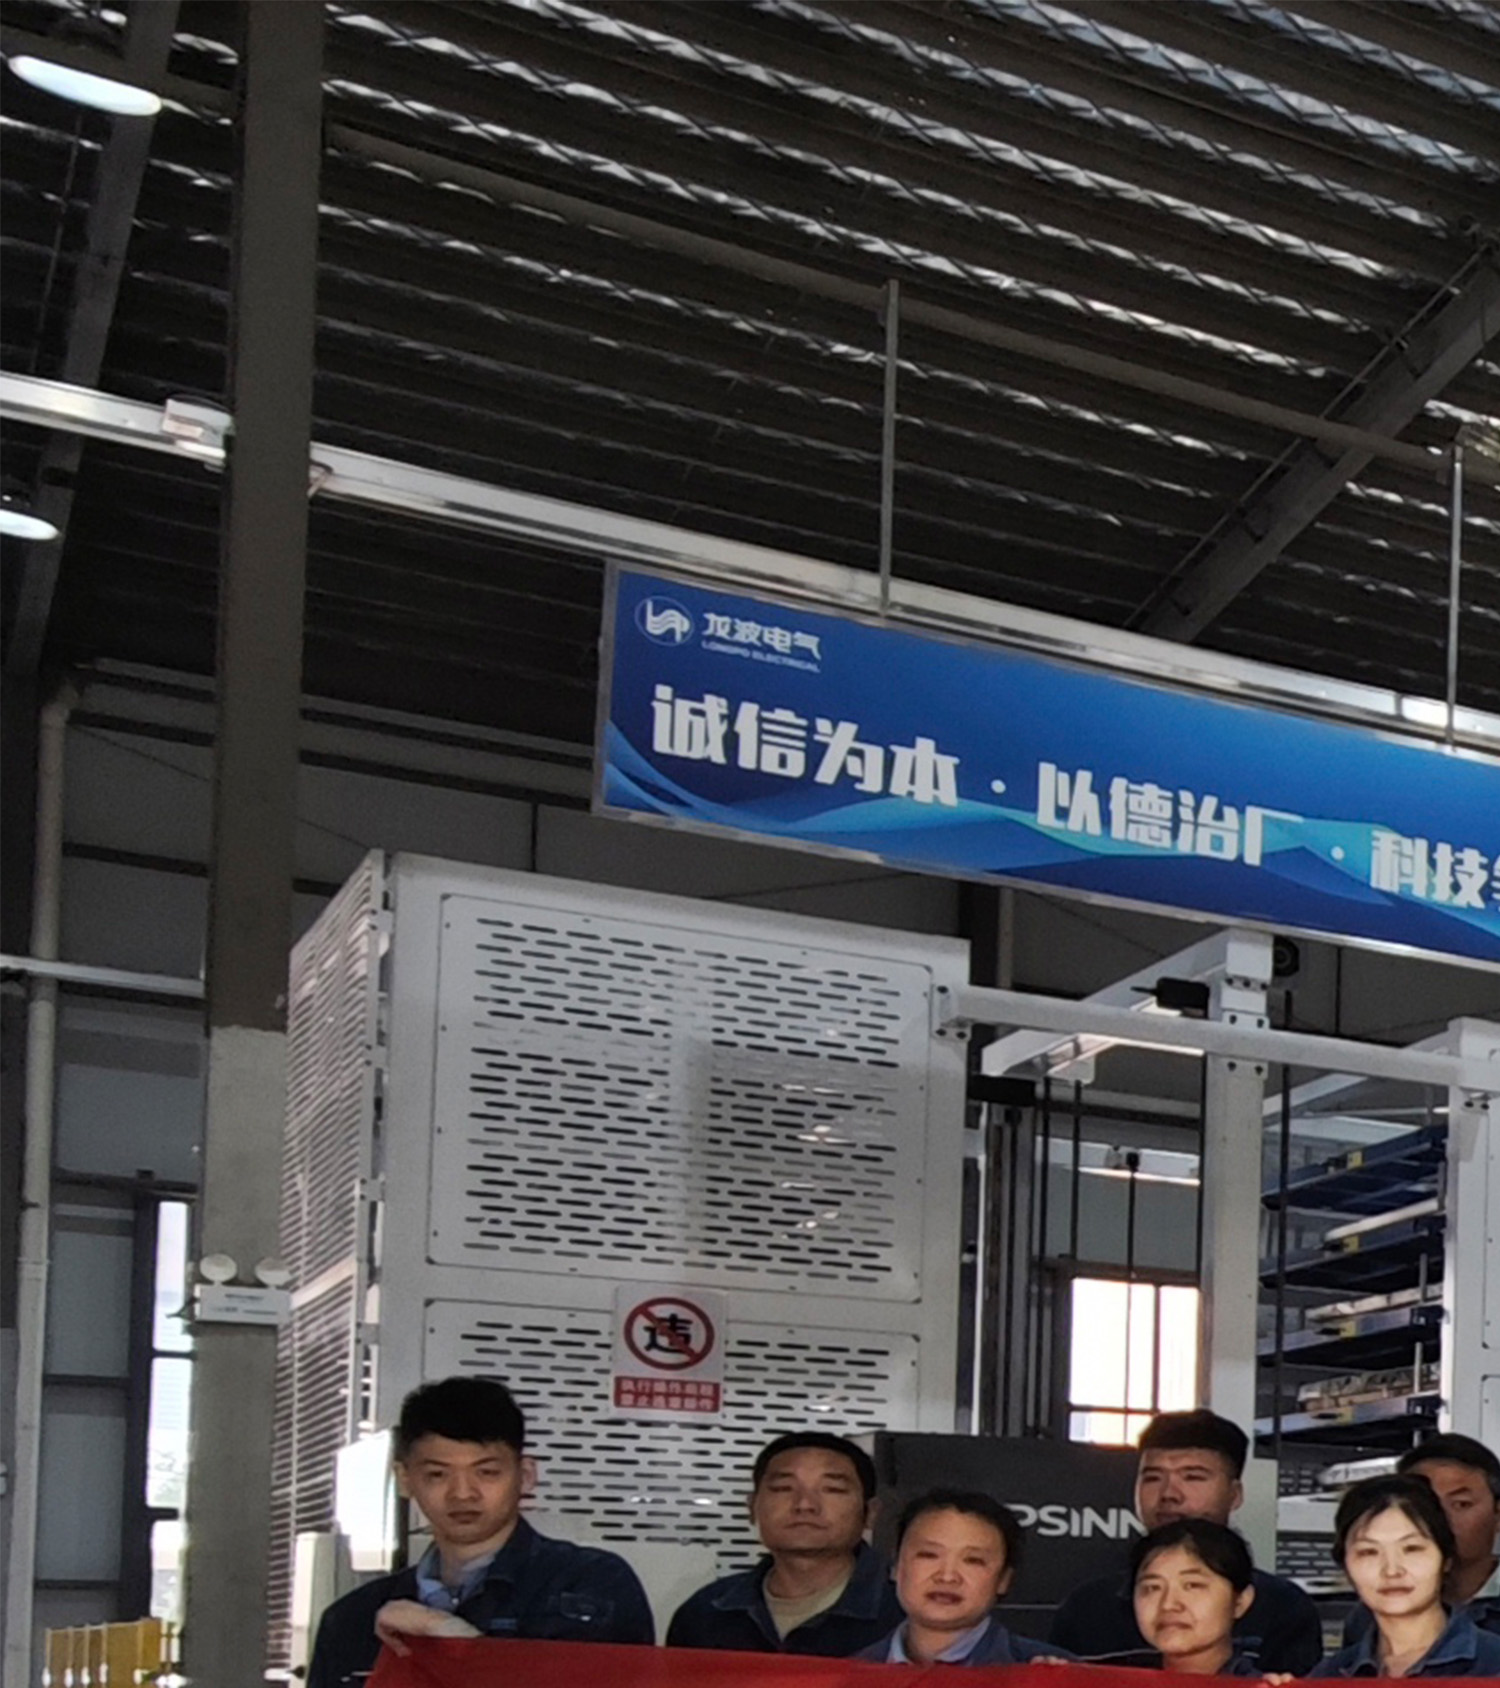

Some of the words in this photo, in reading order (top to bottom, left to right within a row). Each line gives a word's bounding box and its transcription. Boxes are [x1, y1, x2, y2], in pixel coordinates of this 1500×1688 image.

[704, 613, 822, 661] 龙波电气
[643, 1313, 694, 1355] 违
